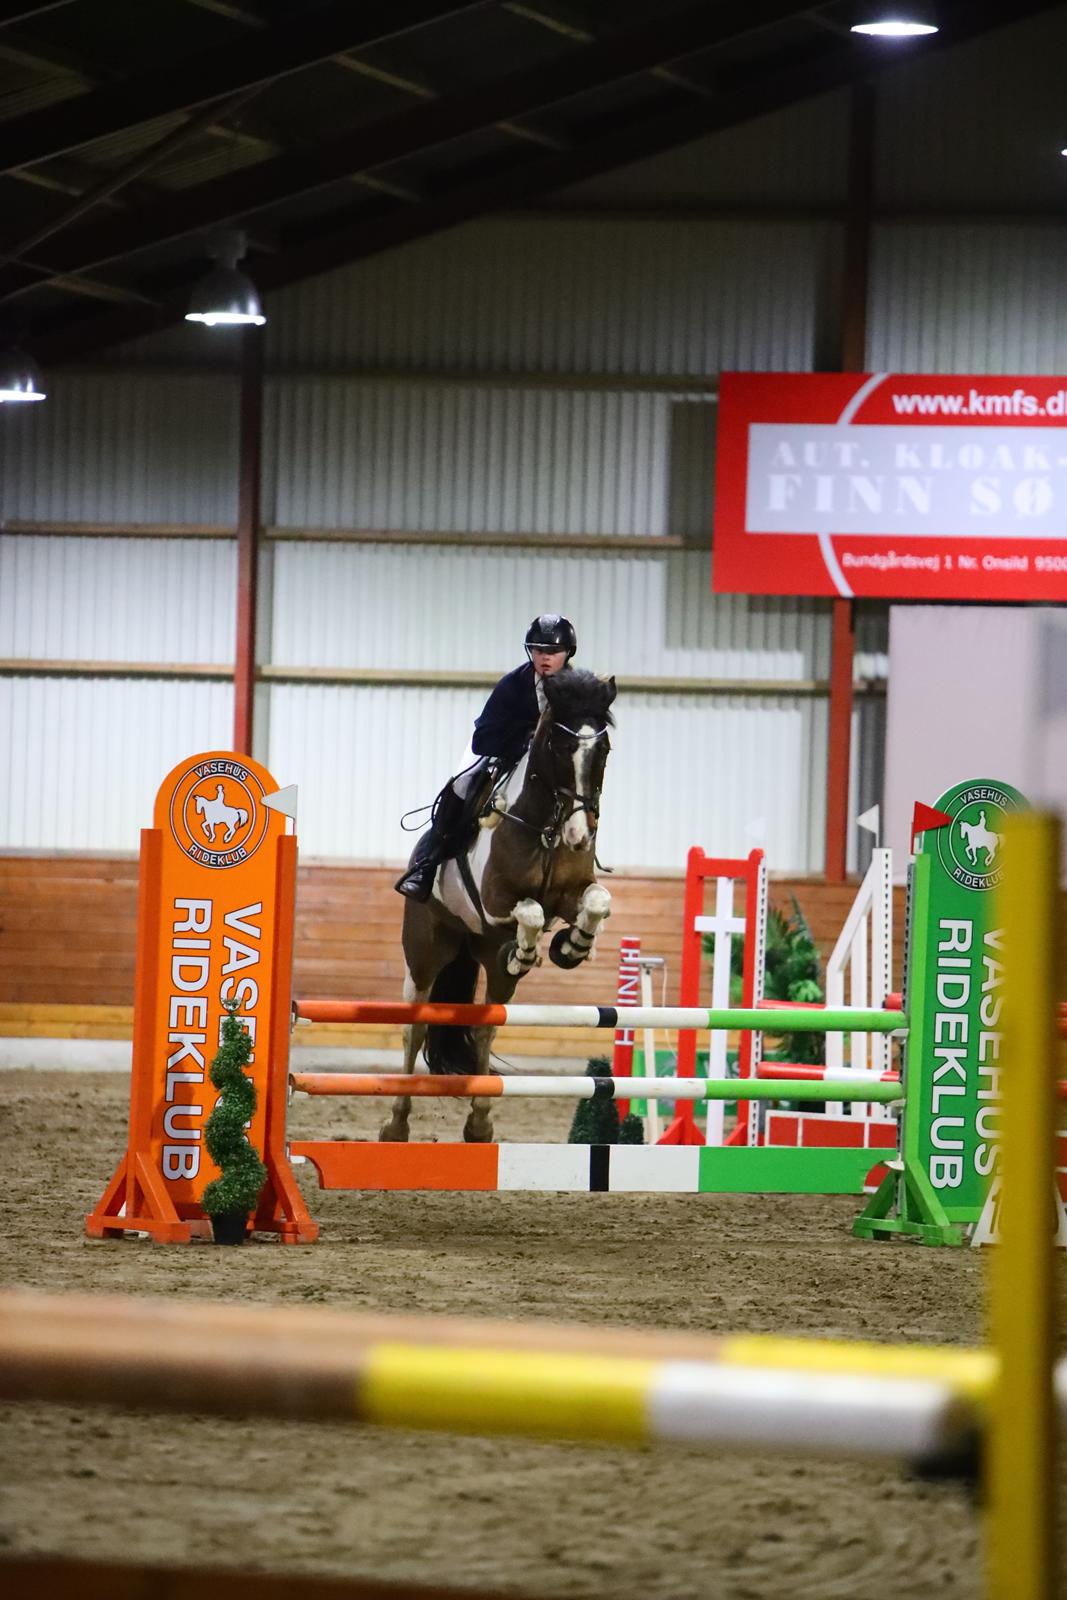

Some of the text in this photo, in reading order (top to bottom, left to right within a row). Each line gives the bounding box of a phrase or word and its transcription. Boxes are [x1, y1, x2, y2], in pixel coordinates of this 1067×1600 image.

[771, 440, 872, 468] AUT.
[765, 474, 1067, 520] FINN SØ
[194, 762, 248, 782] VASEHUS
[960, 789, 1008, 807] VASEHUS
[188, 845, 247, 865] RIDEKLUB
[162, 898, 213, 1180] RIDEKLUB
[929, 918, 973, 1189] RIDEKLUB
